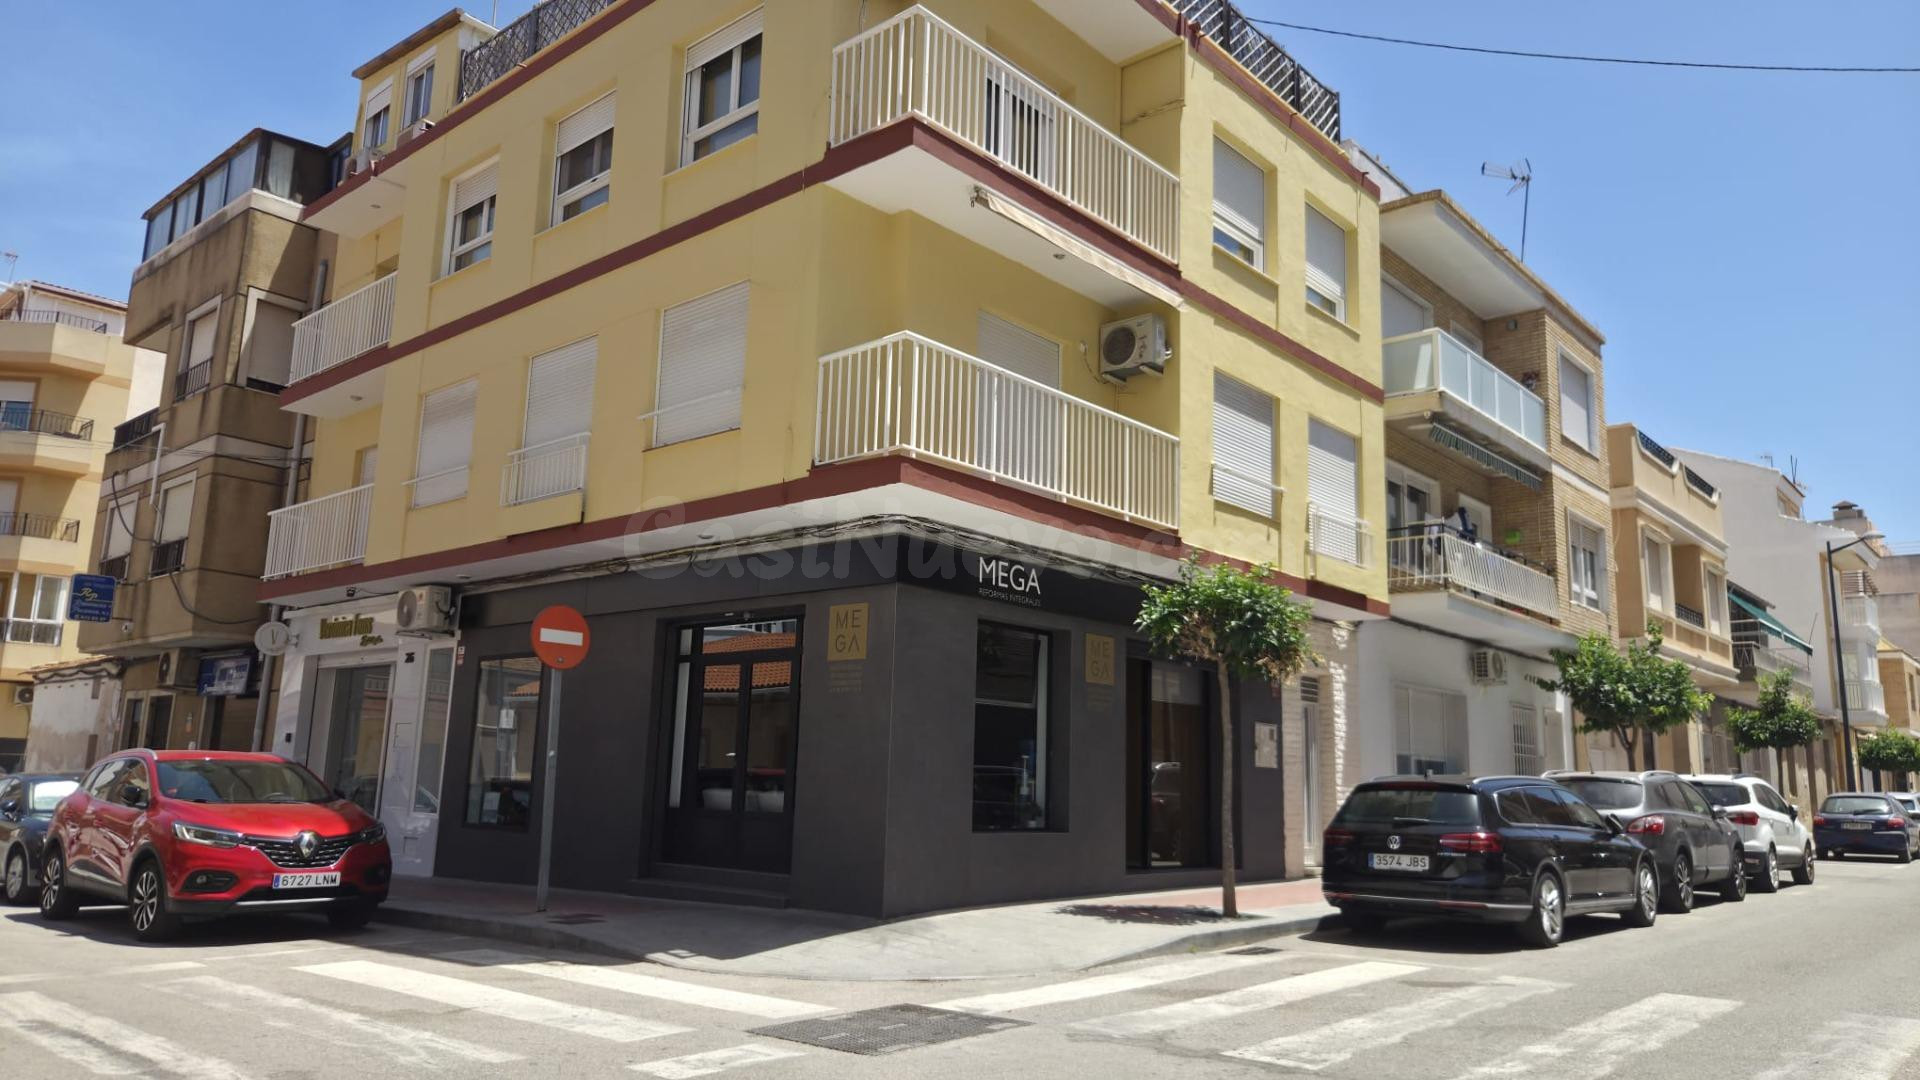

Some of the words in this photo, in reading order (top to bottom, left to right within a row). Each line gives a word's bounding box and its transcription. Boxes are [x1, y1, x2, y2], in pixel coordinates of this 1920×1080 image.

[979, 556, 1041, 595] MEGA
[1375, 854, 1402, 867] 3574
[1406, 855, 1427, 868] JBS
[281, 875, 312, 886] 6727
[315, 874, 338, 886] LNM
